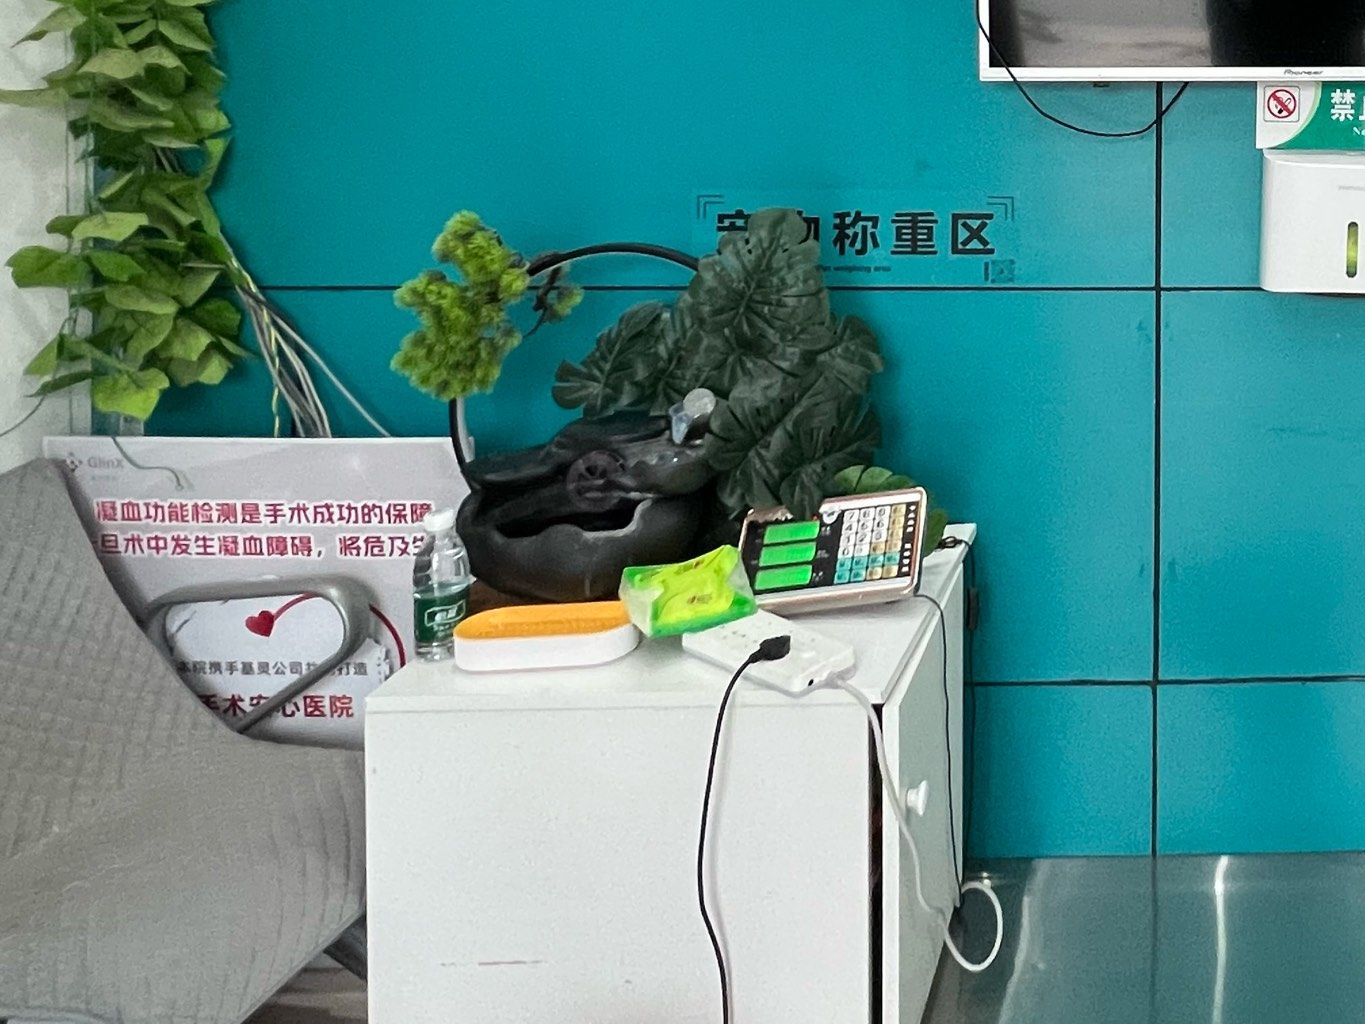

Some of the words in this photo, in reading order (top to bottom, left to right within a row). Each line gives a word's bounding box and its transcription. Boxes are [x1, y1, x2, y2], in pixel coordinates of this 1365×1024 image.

[96, 500, 433, 525] 凝血功能检测是手术成功的保障
